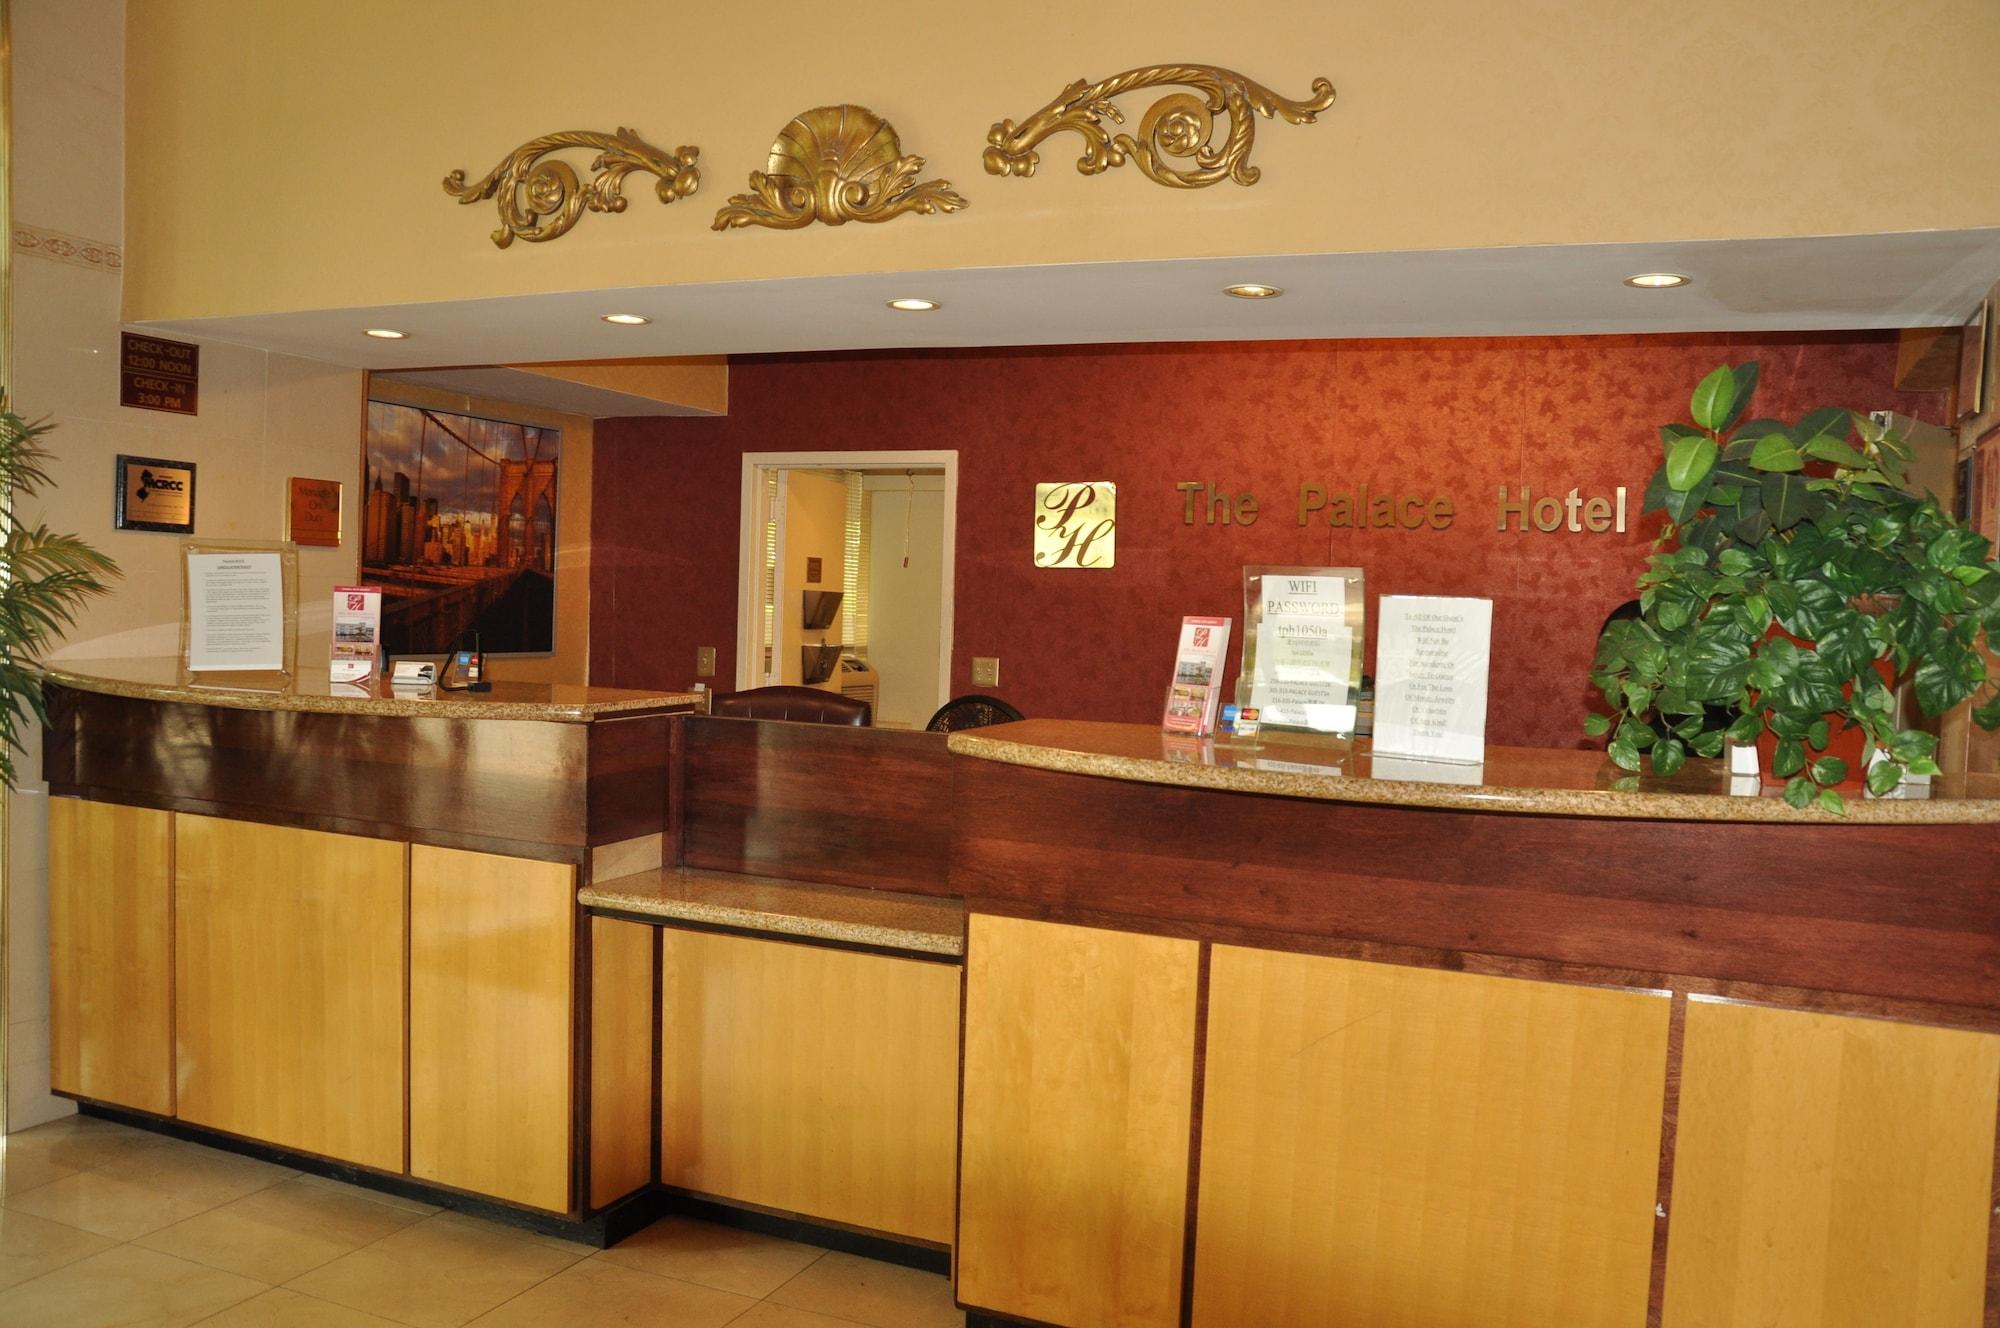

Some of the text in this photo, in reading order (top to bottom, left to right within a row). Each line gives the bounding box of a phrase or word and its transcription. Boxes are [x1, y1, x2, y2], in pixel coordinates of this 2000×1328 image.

[127, 339, 191, 359] CHECK-OUT
[128, 355, 191, 374] 12:00 NOON
[134, 377, 186, 394] CHECK-IN
[138, 392, 182, 409] 3:00 PM
[144, 479, 183, 491] MCRCC
[1177, 482, 1627, 534] The Palace Hotel
[1288, 580, 1317, 594] WIFI
[1268, 600, 1340, 616] PASSWORD
[1278, 624, 1328, 639] tph1050a
